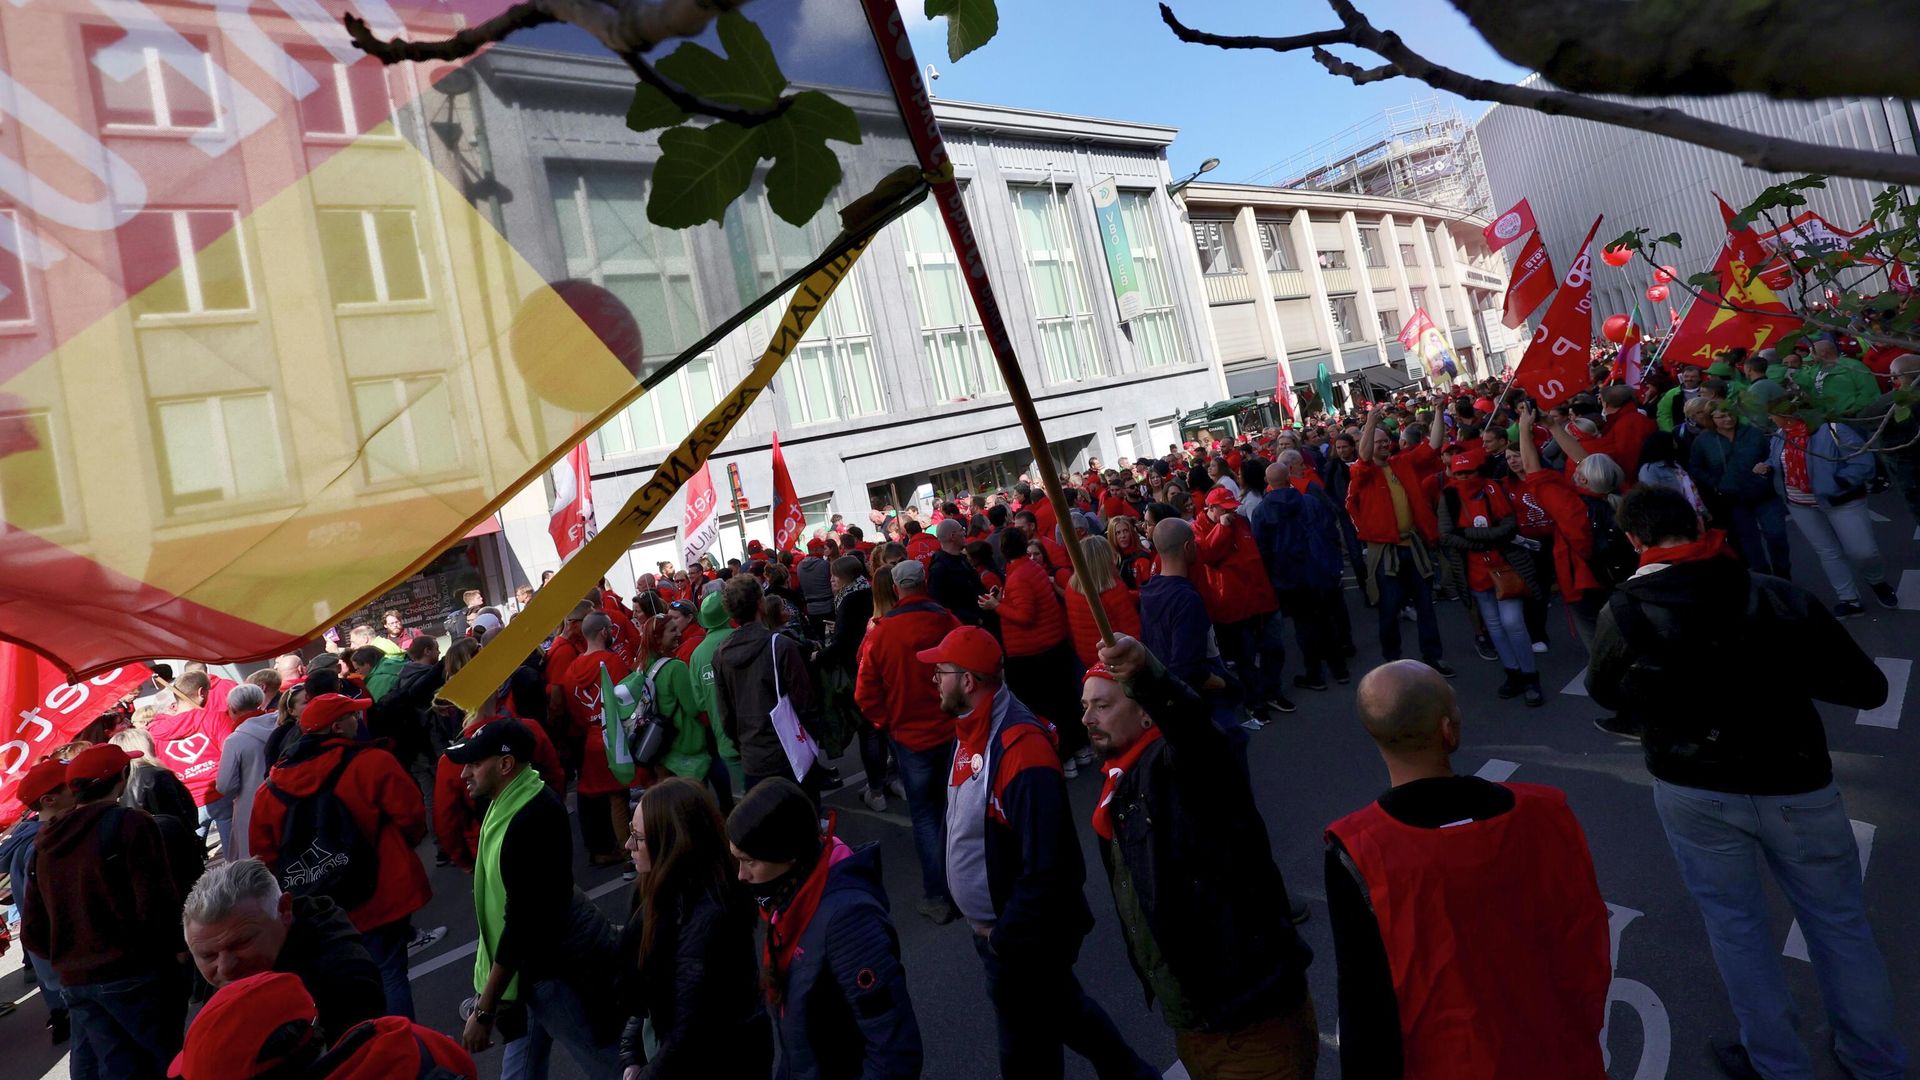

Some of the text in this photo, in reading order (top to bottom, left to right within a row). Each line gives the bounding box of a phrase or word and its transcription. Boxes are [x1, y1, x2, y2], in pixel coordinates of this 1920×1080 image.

[1105, 212, 1130, 288] VBO FEB
[184, 759, 217, 775] SUPER
[283, 852, 350, 889] adidas
